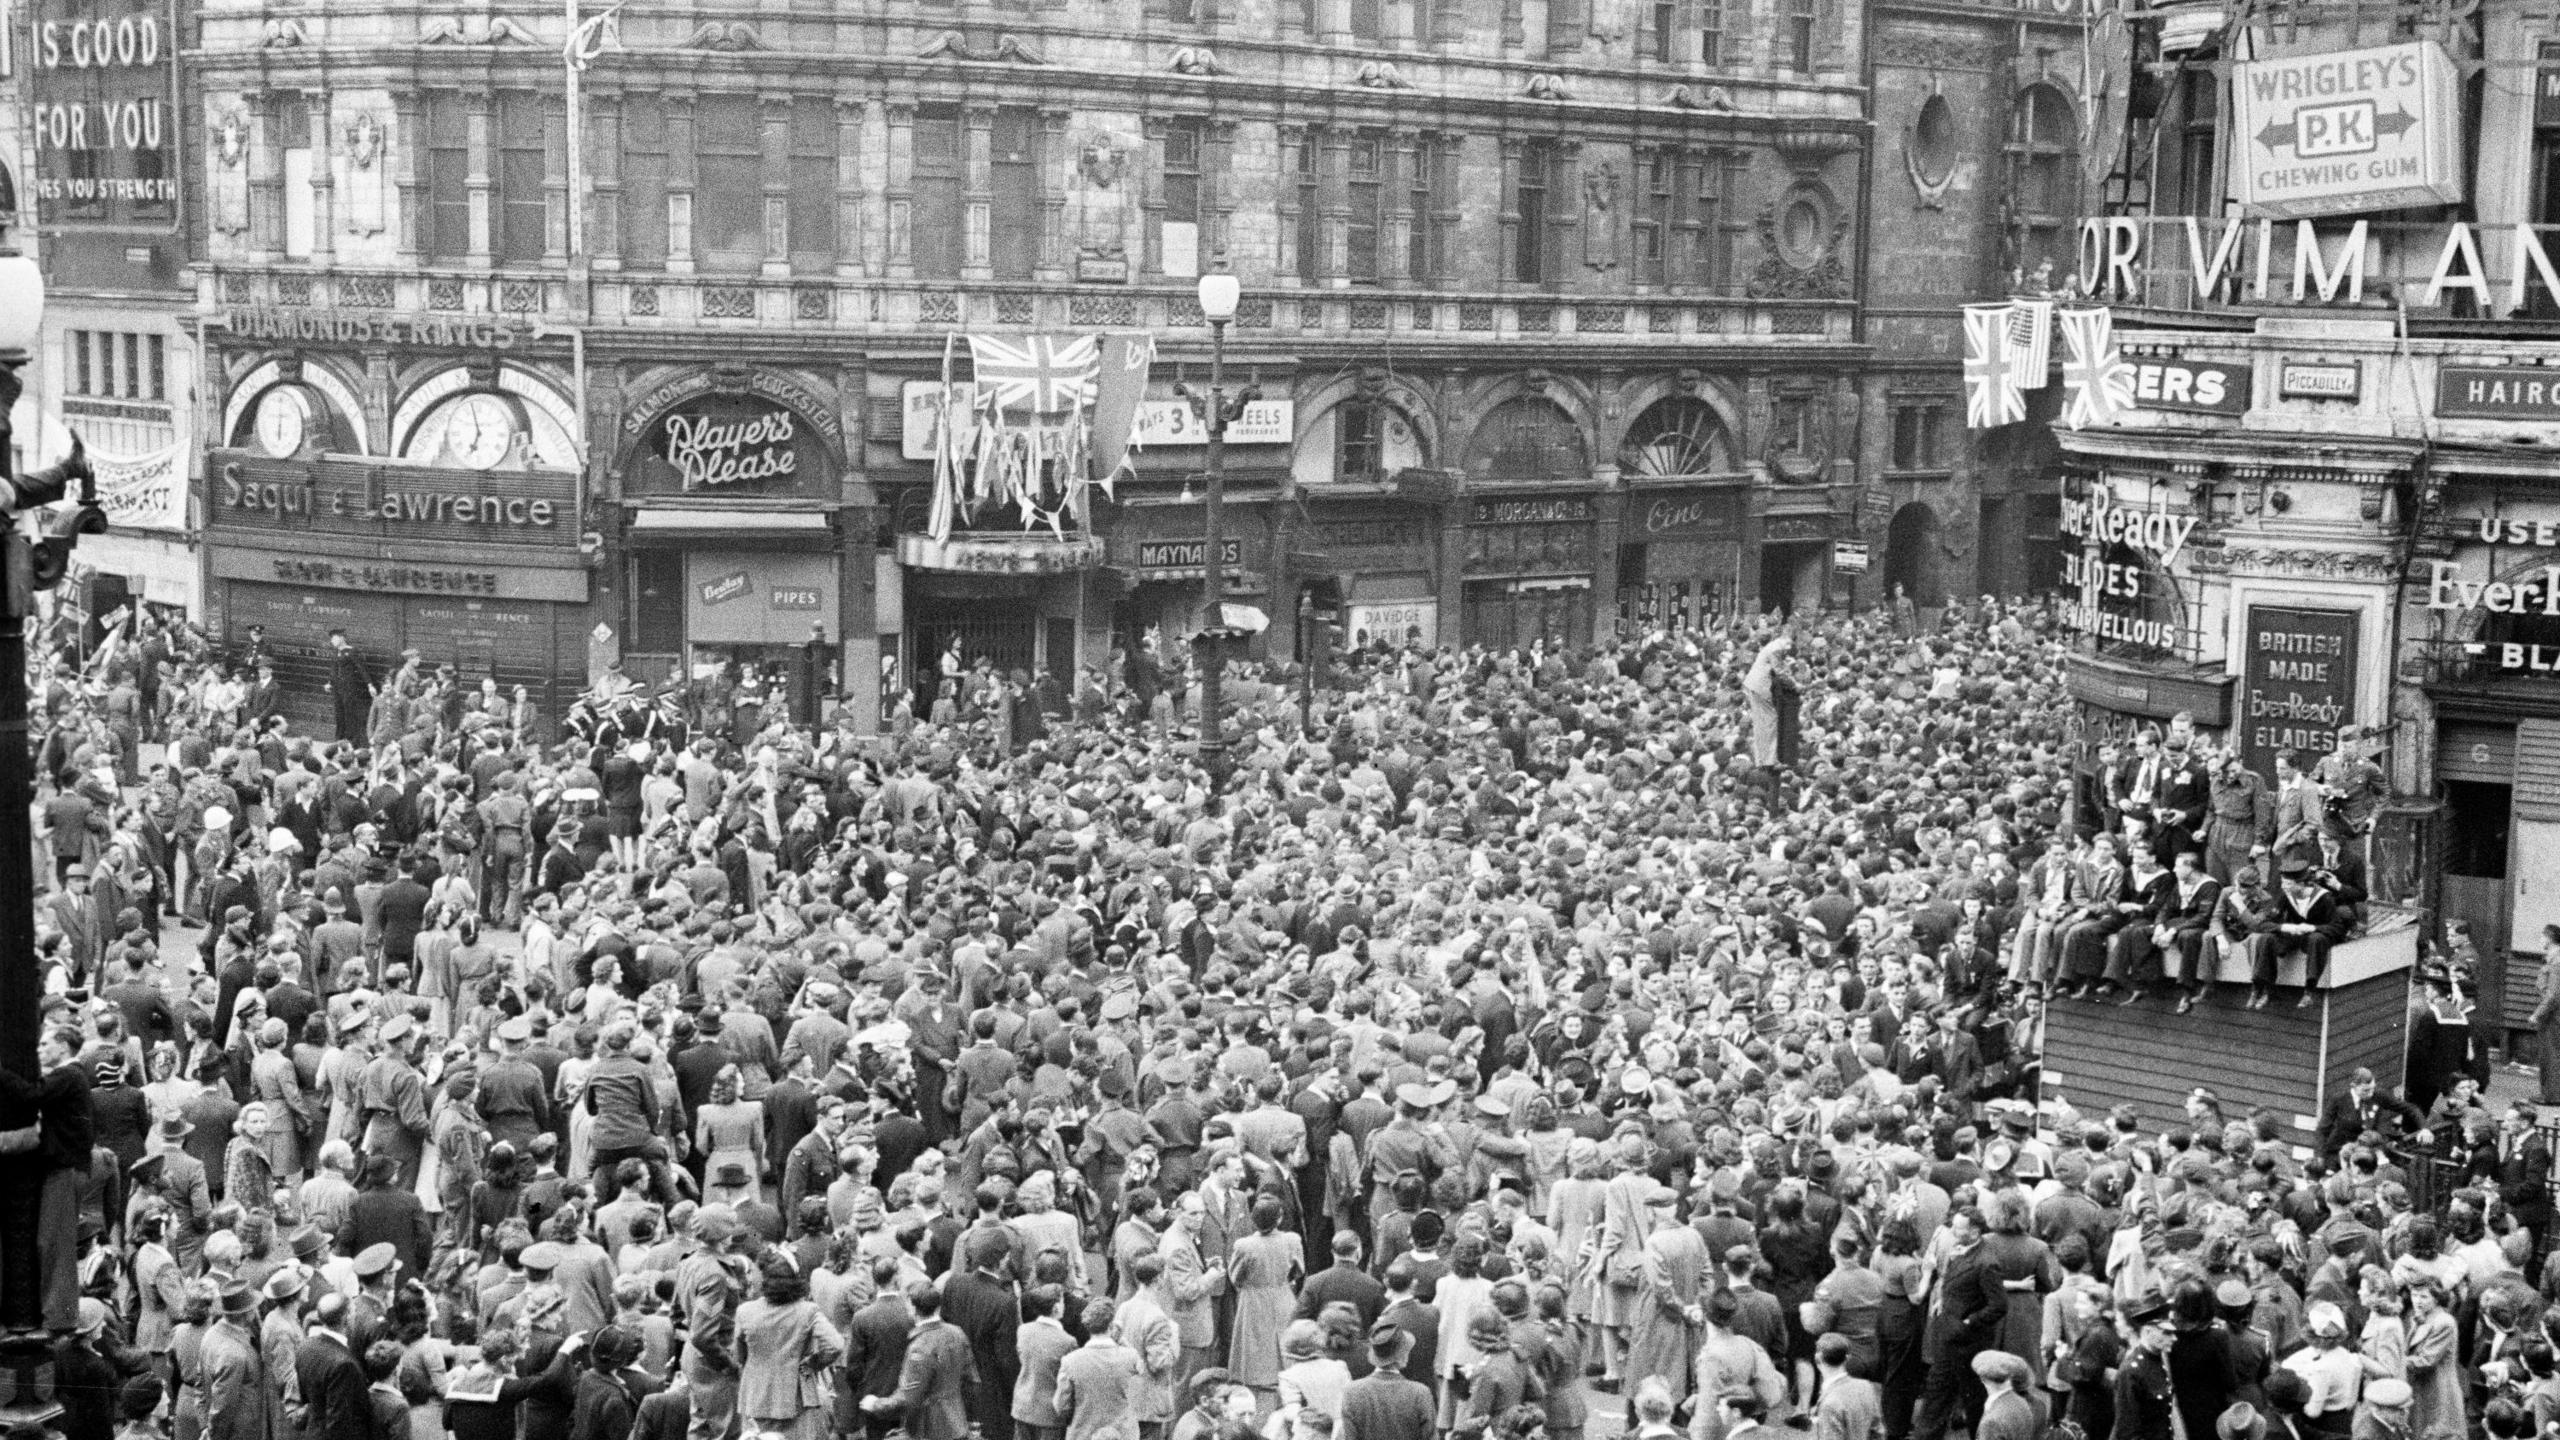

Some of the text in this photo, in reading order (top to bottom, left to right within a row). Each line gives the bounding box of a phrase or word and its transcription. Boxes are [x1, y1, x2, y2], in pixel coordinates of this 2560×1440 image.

[32, 16, 158, 69] IS GOOD
[34, 99, 160, 150] FOR YOU
[2305, 110, 2371, 149] P.K.
[66, 177, 95, 199] YOU
[99, 178, 177, 200] STRENGTH
[2258, 156, 2419, 191] CHEWING GUM
[2186, 216, 2368, 302] VIM
[230, 312, 372, 342] DIAMONDS
[411, 321, 515, 349] RINGS
[624, 379, 683, 433] SALMON
[1170, 407, 1185, 435] 3
[666, 411, 793, 465] Player's
[680, 446, 796, 491] Please
[224, 462, 312, 521] Saqui
[365, 470, 553, 525] Lawrence
[2480, 517, 2556, 547] USE
[1141, 543, 1238, 567] MAYNADS
[774, 591, 816, 604] PIPES
[2260, 631, 2342, 657] BRITISH
[2269, 660, 2329, 682] MADE
[2255, 726, 2335, 752] BLADES
[2470, 744, 2491, 763] 6
